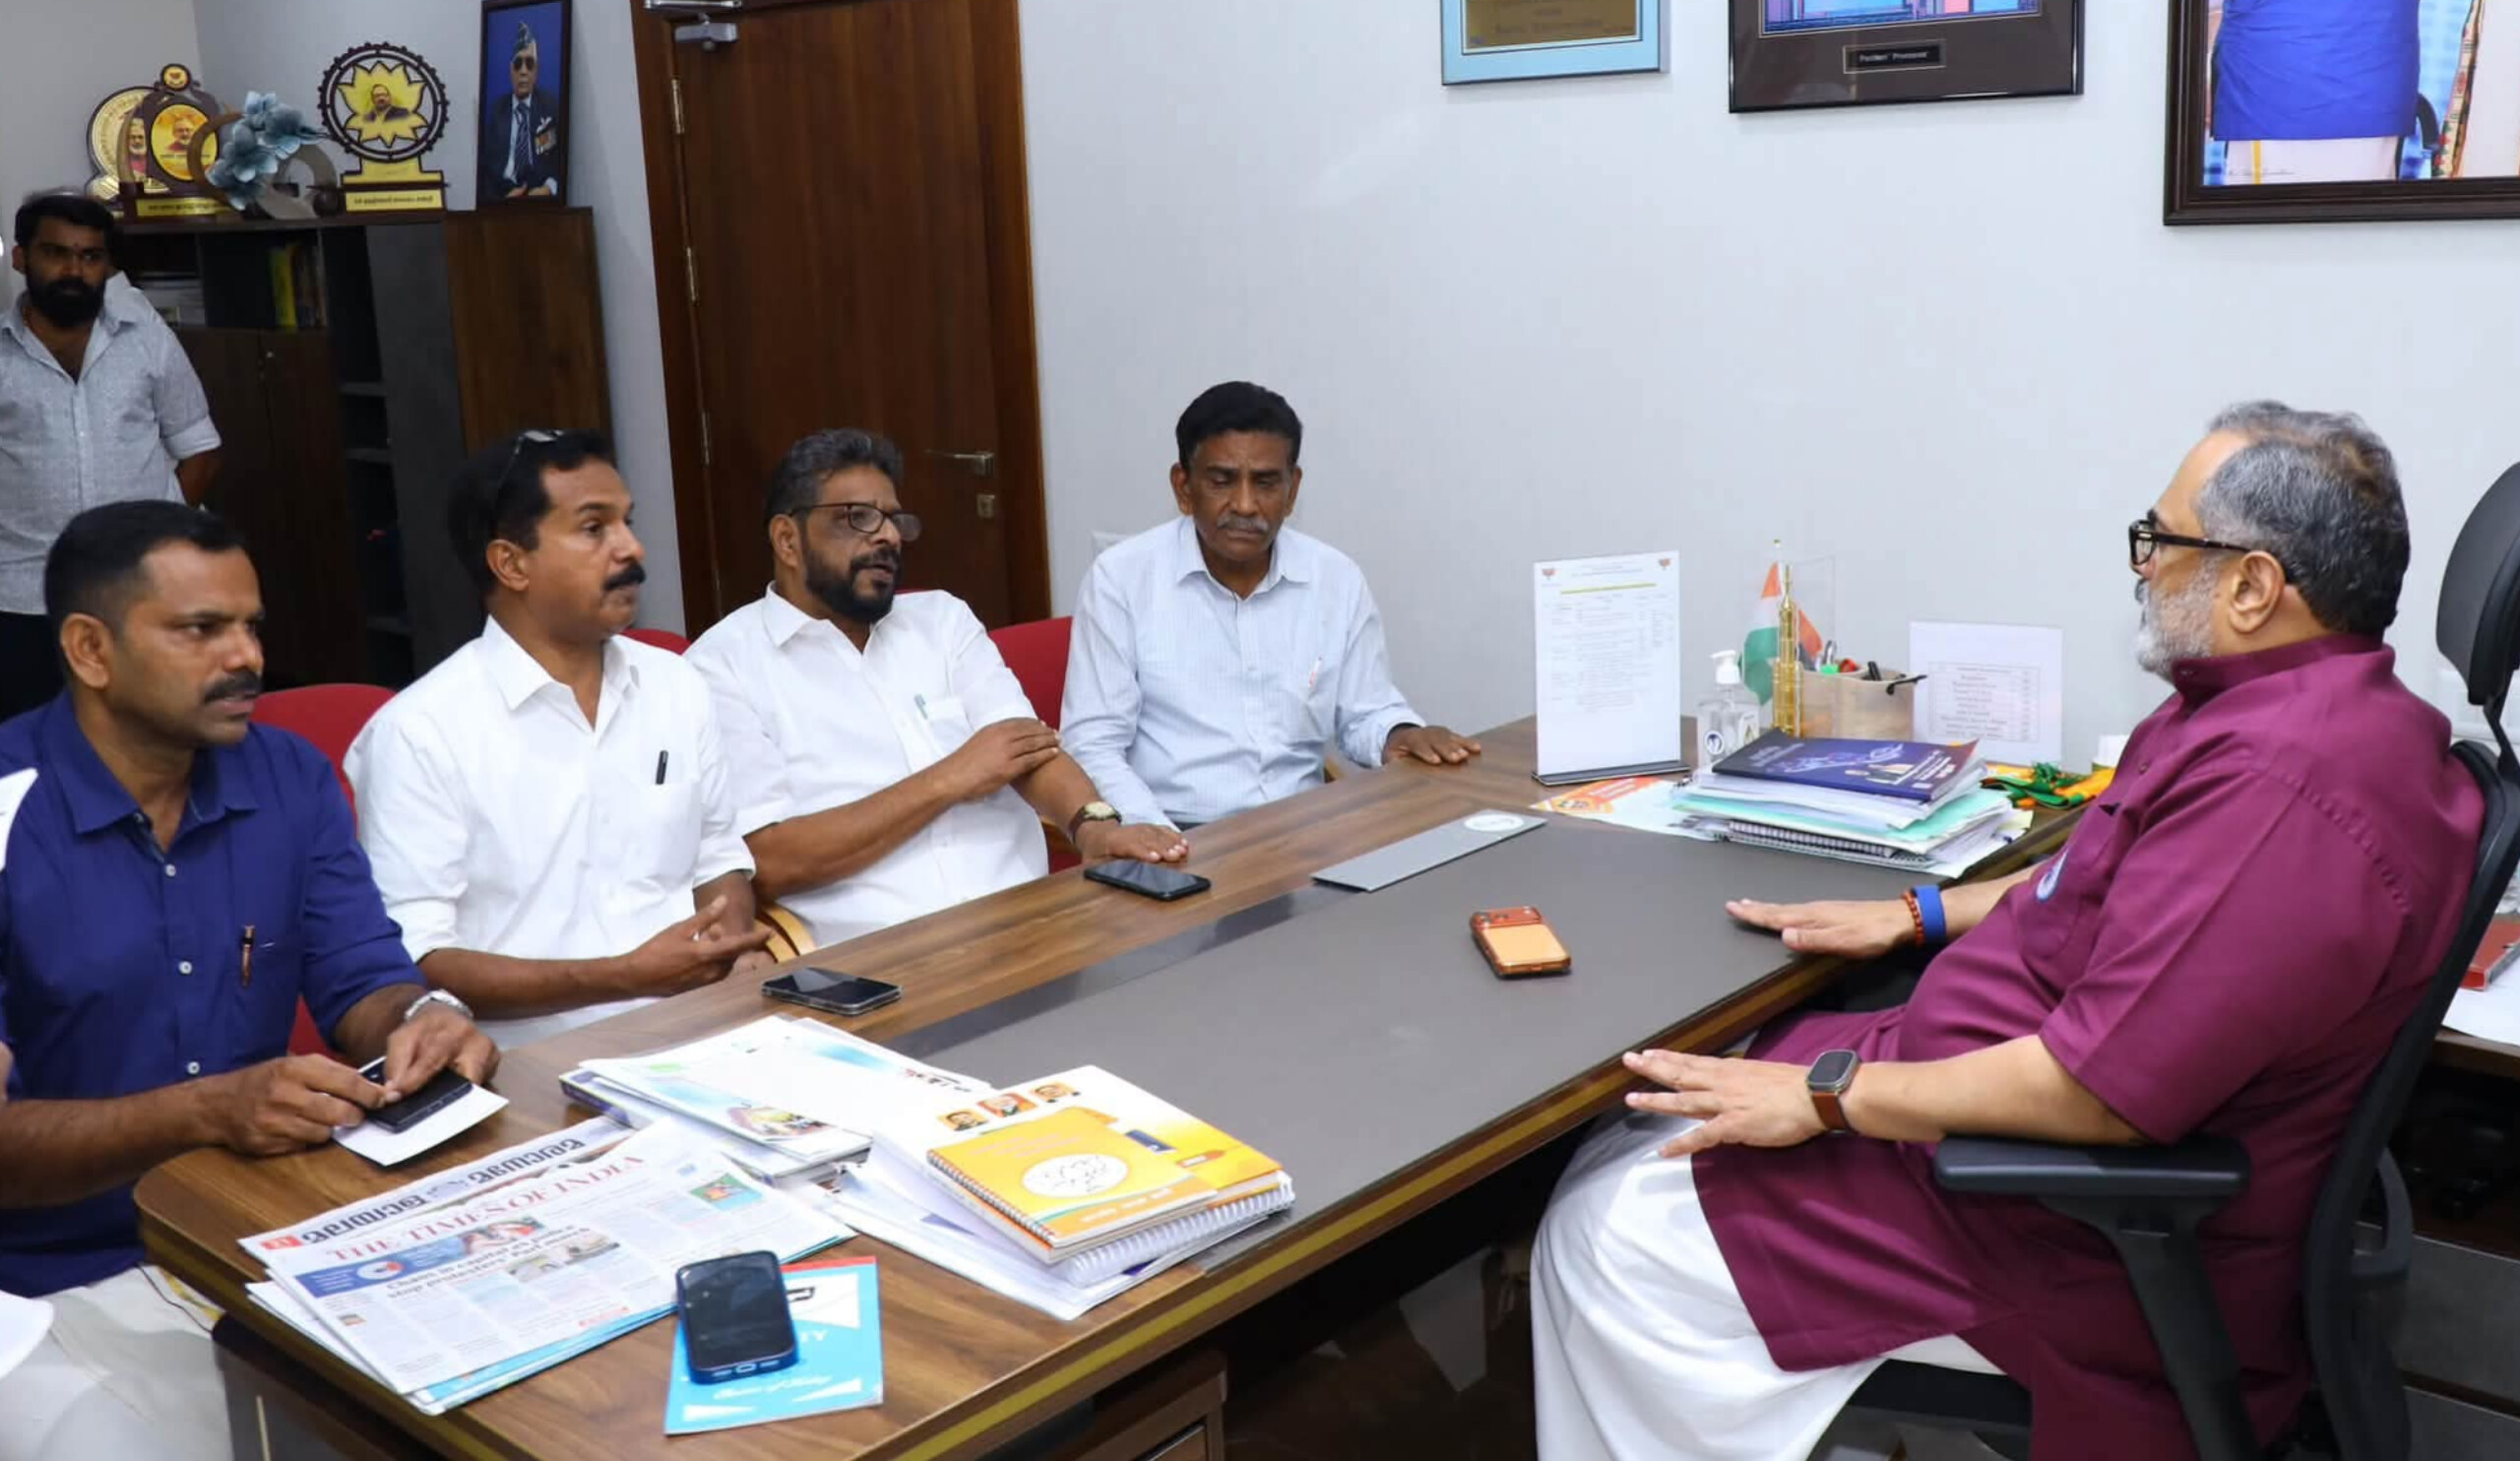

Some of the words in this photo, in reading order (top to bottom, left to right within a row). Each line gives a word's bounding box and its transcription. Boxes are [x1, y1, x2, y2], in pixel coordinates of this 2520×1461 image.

[302, 1193, 429, 1243] മലയാള
[468, 1138, 587, 1183] മനോരമ
[327, 1239, 398, 1260] THE
[405, 1204, 507, 1240] TIMES
[507, 1189, 548, 1208] OF
[554, 1155, 646, 1192] INDIA
